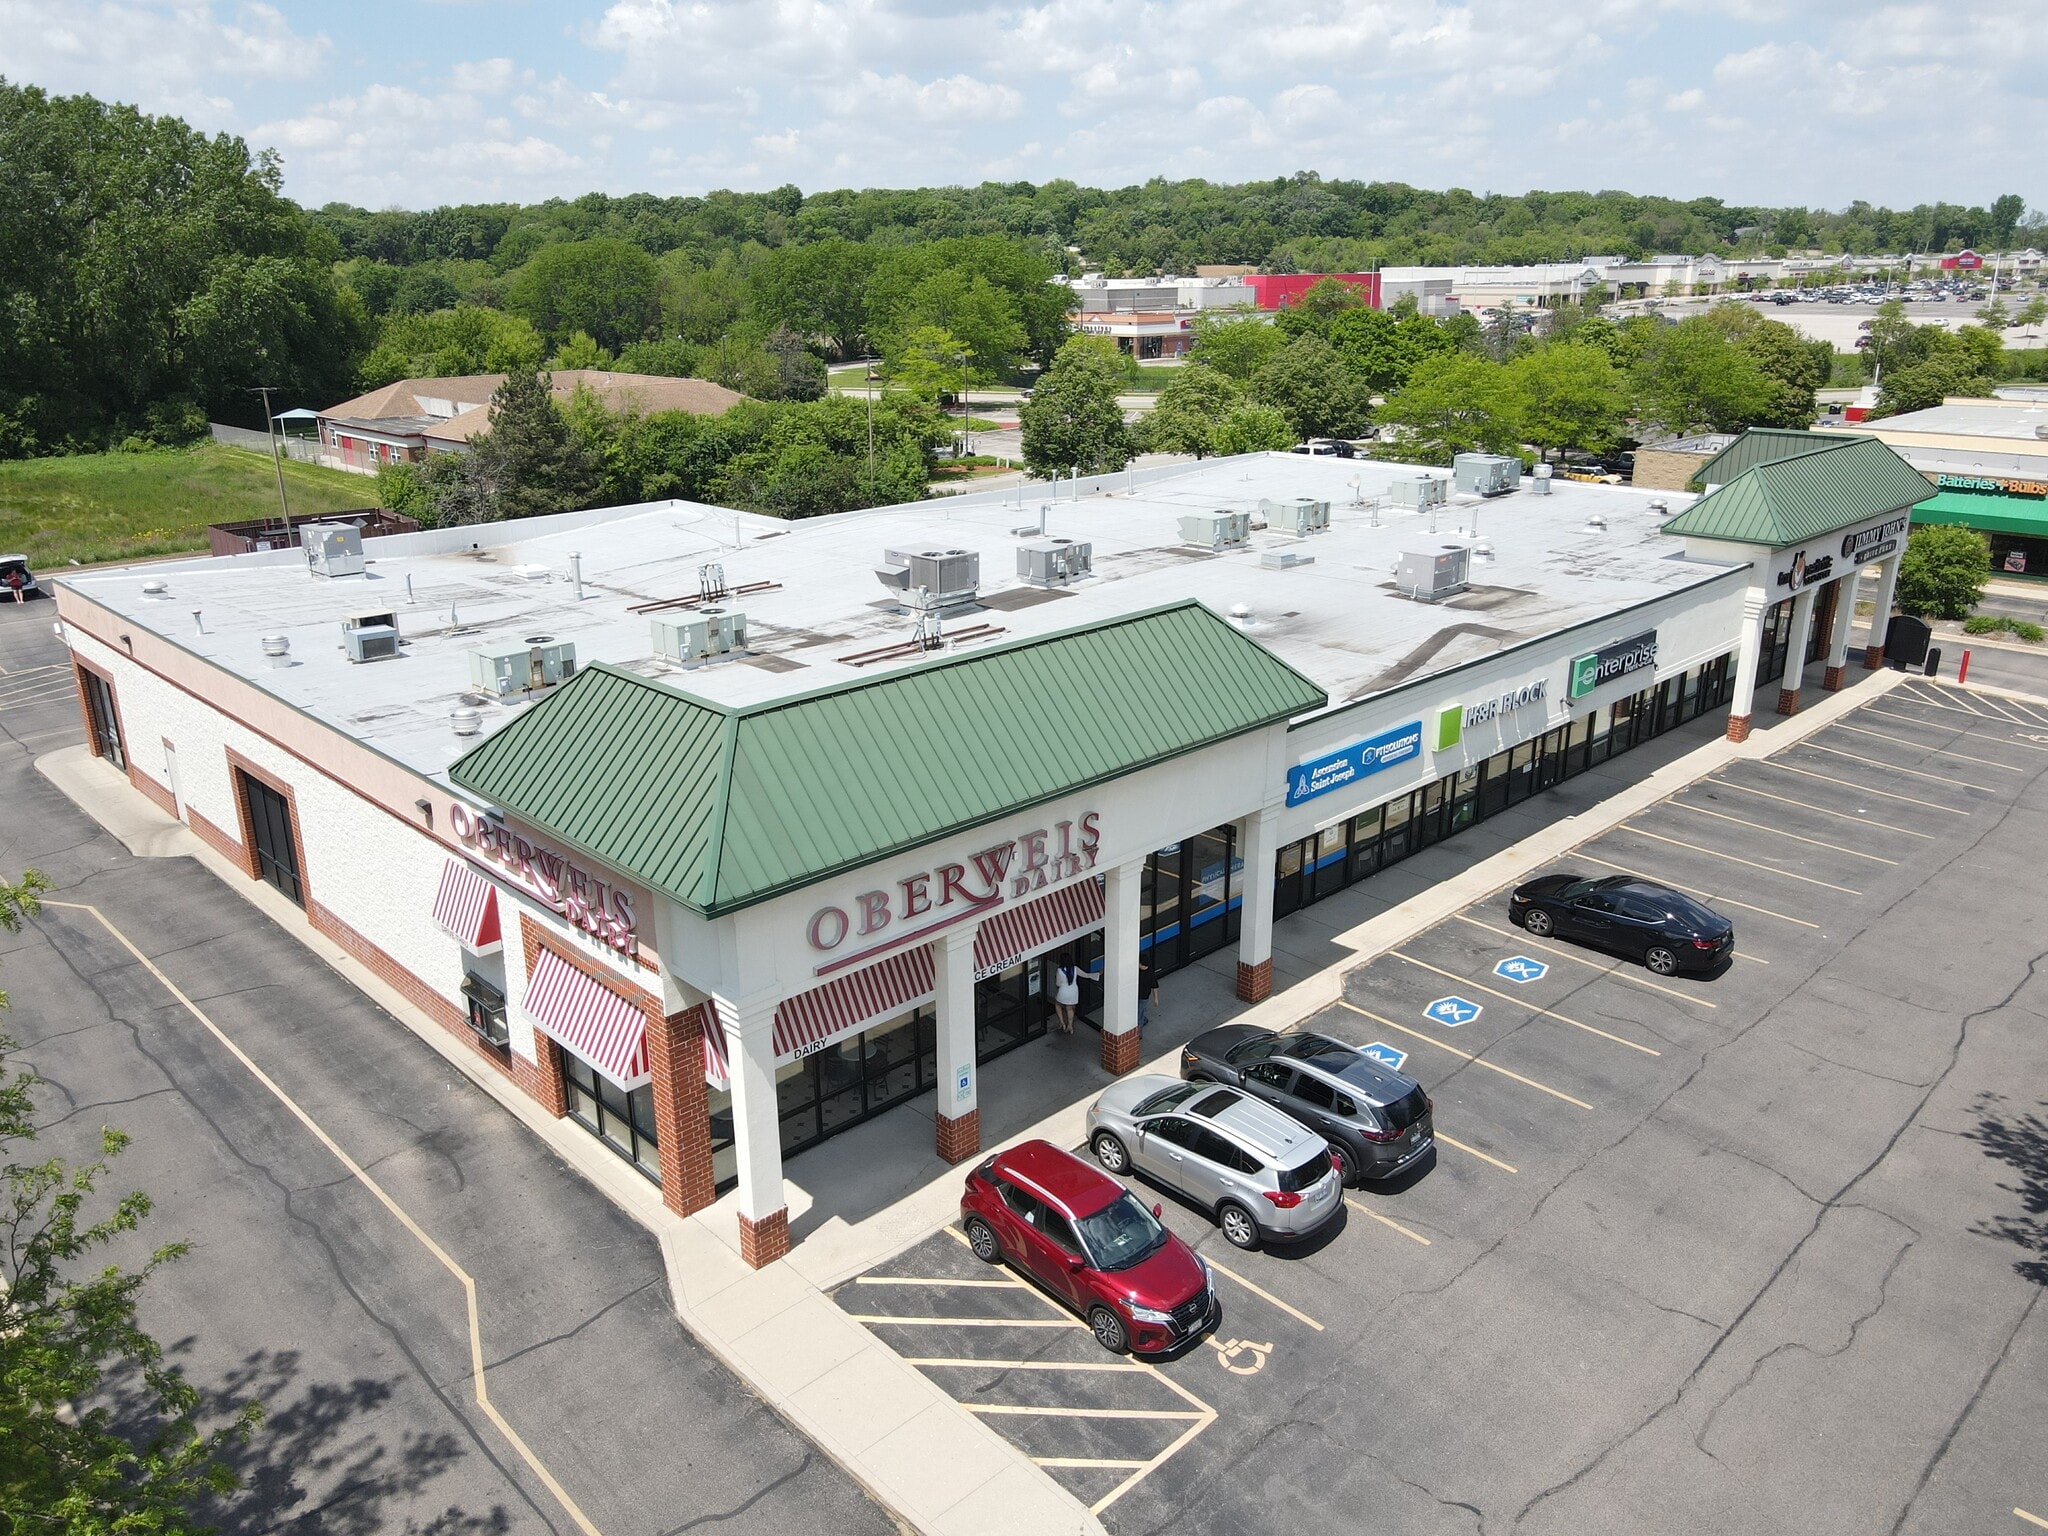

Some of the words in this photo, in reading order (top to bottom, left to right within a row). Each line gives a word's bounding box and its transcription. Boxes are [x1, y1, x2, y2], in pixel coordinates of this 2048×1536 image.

[1938, 474, 1995, 490] Batteries
[2009, 480, 2047, 495] Bulbs
[1854, 526, 1882, 551] JIMMY
[1579, 642, 1658, 685] enterprise
[1464, 699, 1499, 728] H&R
[1501, 679, 1549, 714] BLOCK
[1310, 775, 1329, 793] Saint
[1330, 766, 1355, 784] Joseph
[1311, 759, 1348, 780] Ascension
[450, 803, 637, 932] OBERWEIS
[807, 811, 1100, 951] OBERWEIS
[1010, 846, 1100, 899] DAIRY
[565, 897, 639, 955] DAIRY
[974, 968, 987, 981] CE
[990, 954, 1022, 974] CREAM
[794, 1038, 828, 1060] DAIRY
